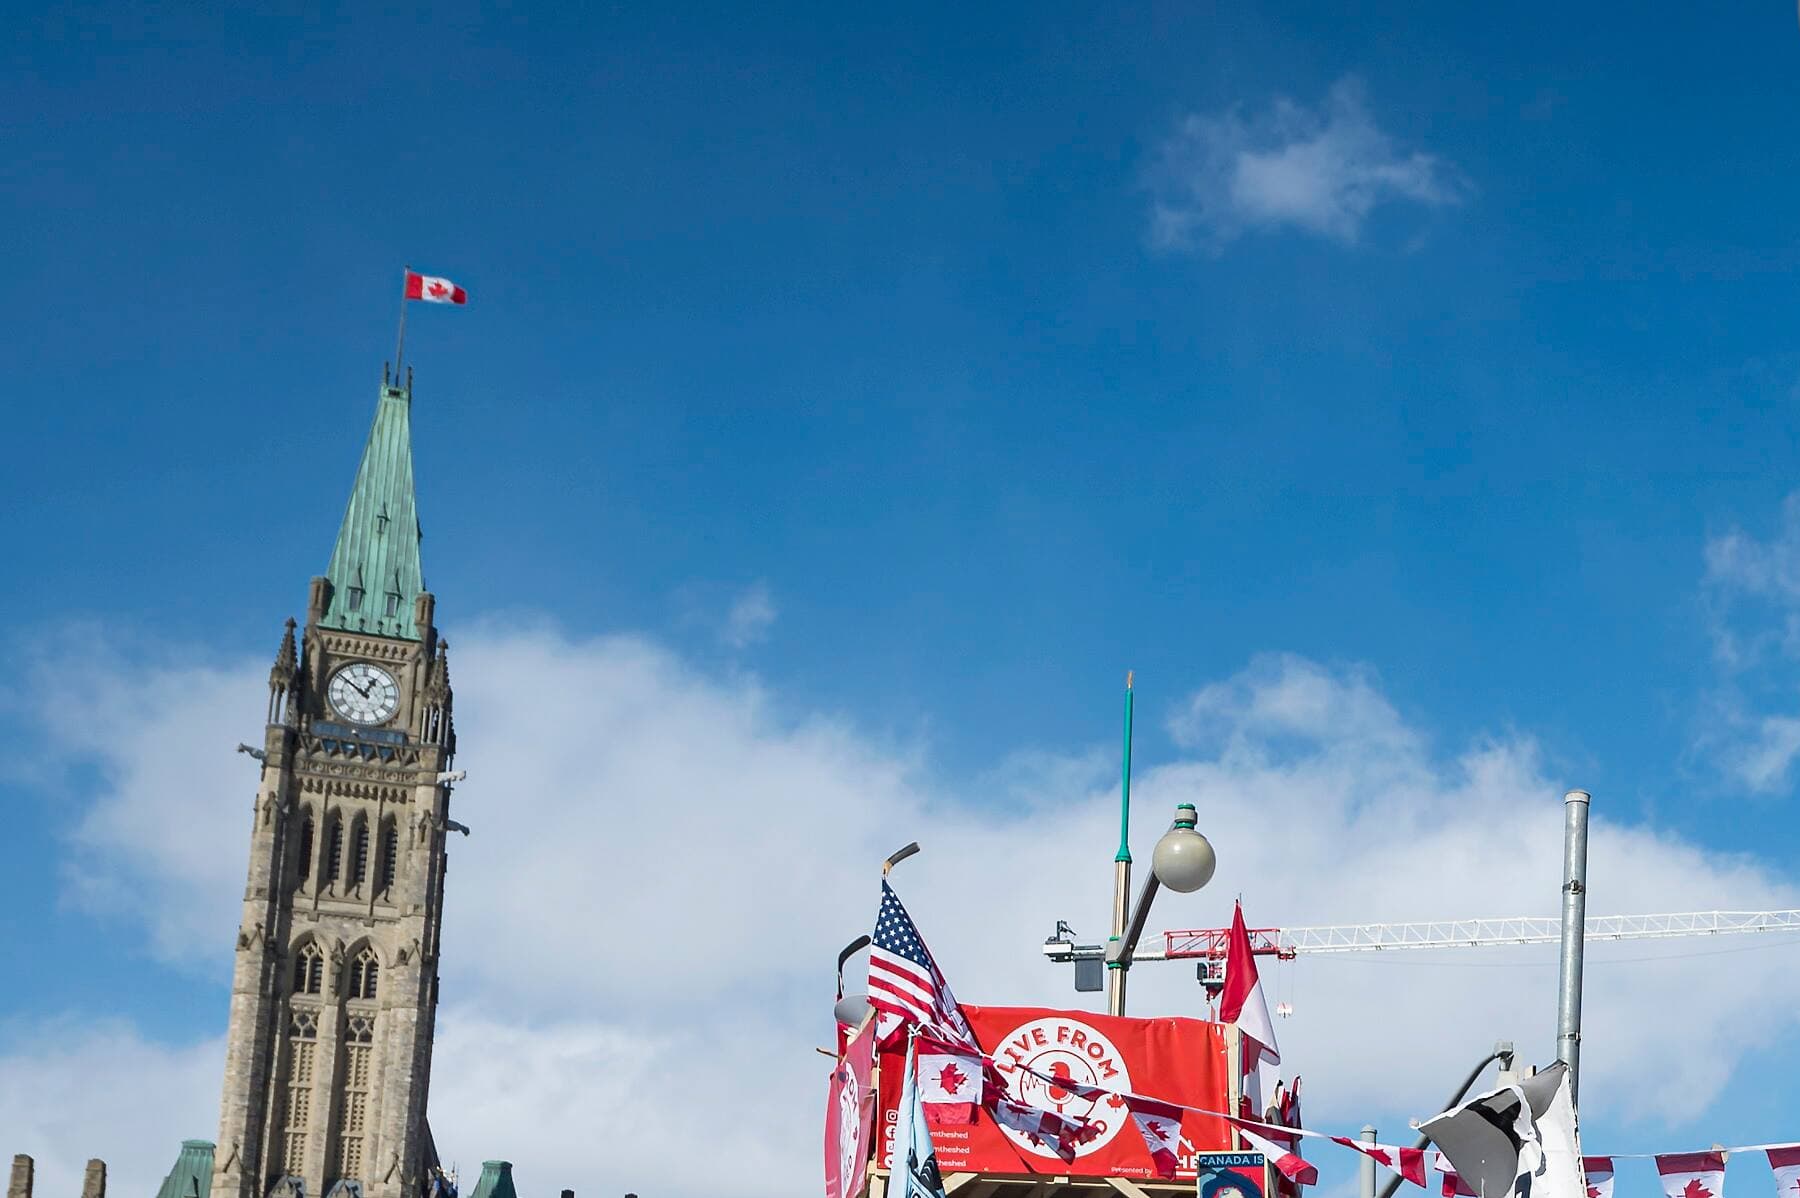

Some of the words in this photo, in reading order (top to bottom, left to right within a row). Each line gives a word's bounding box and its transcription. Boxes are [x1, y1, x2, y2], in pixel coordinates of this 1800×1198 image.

[996, 1027, 1049, 1074] LIVE
[1056, 1025, 1119, 1079] FROM
[1200, 1155, 1250, 1166] CANADA
[1253, 1154, 1264, 1164] IS
